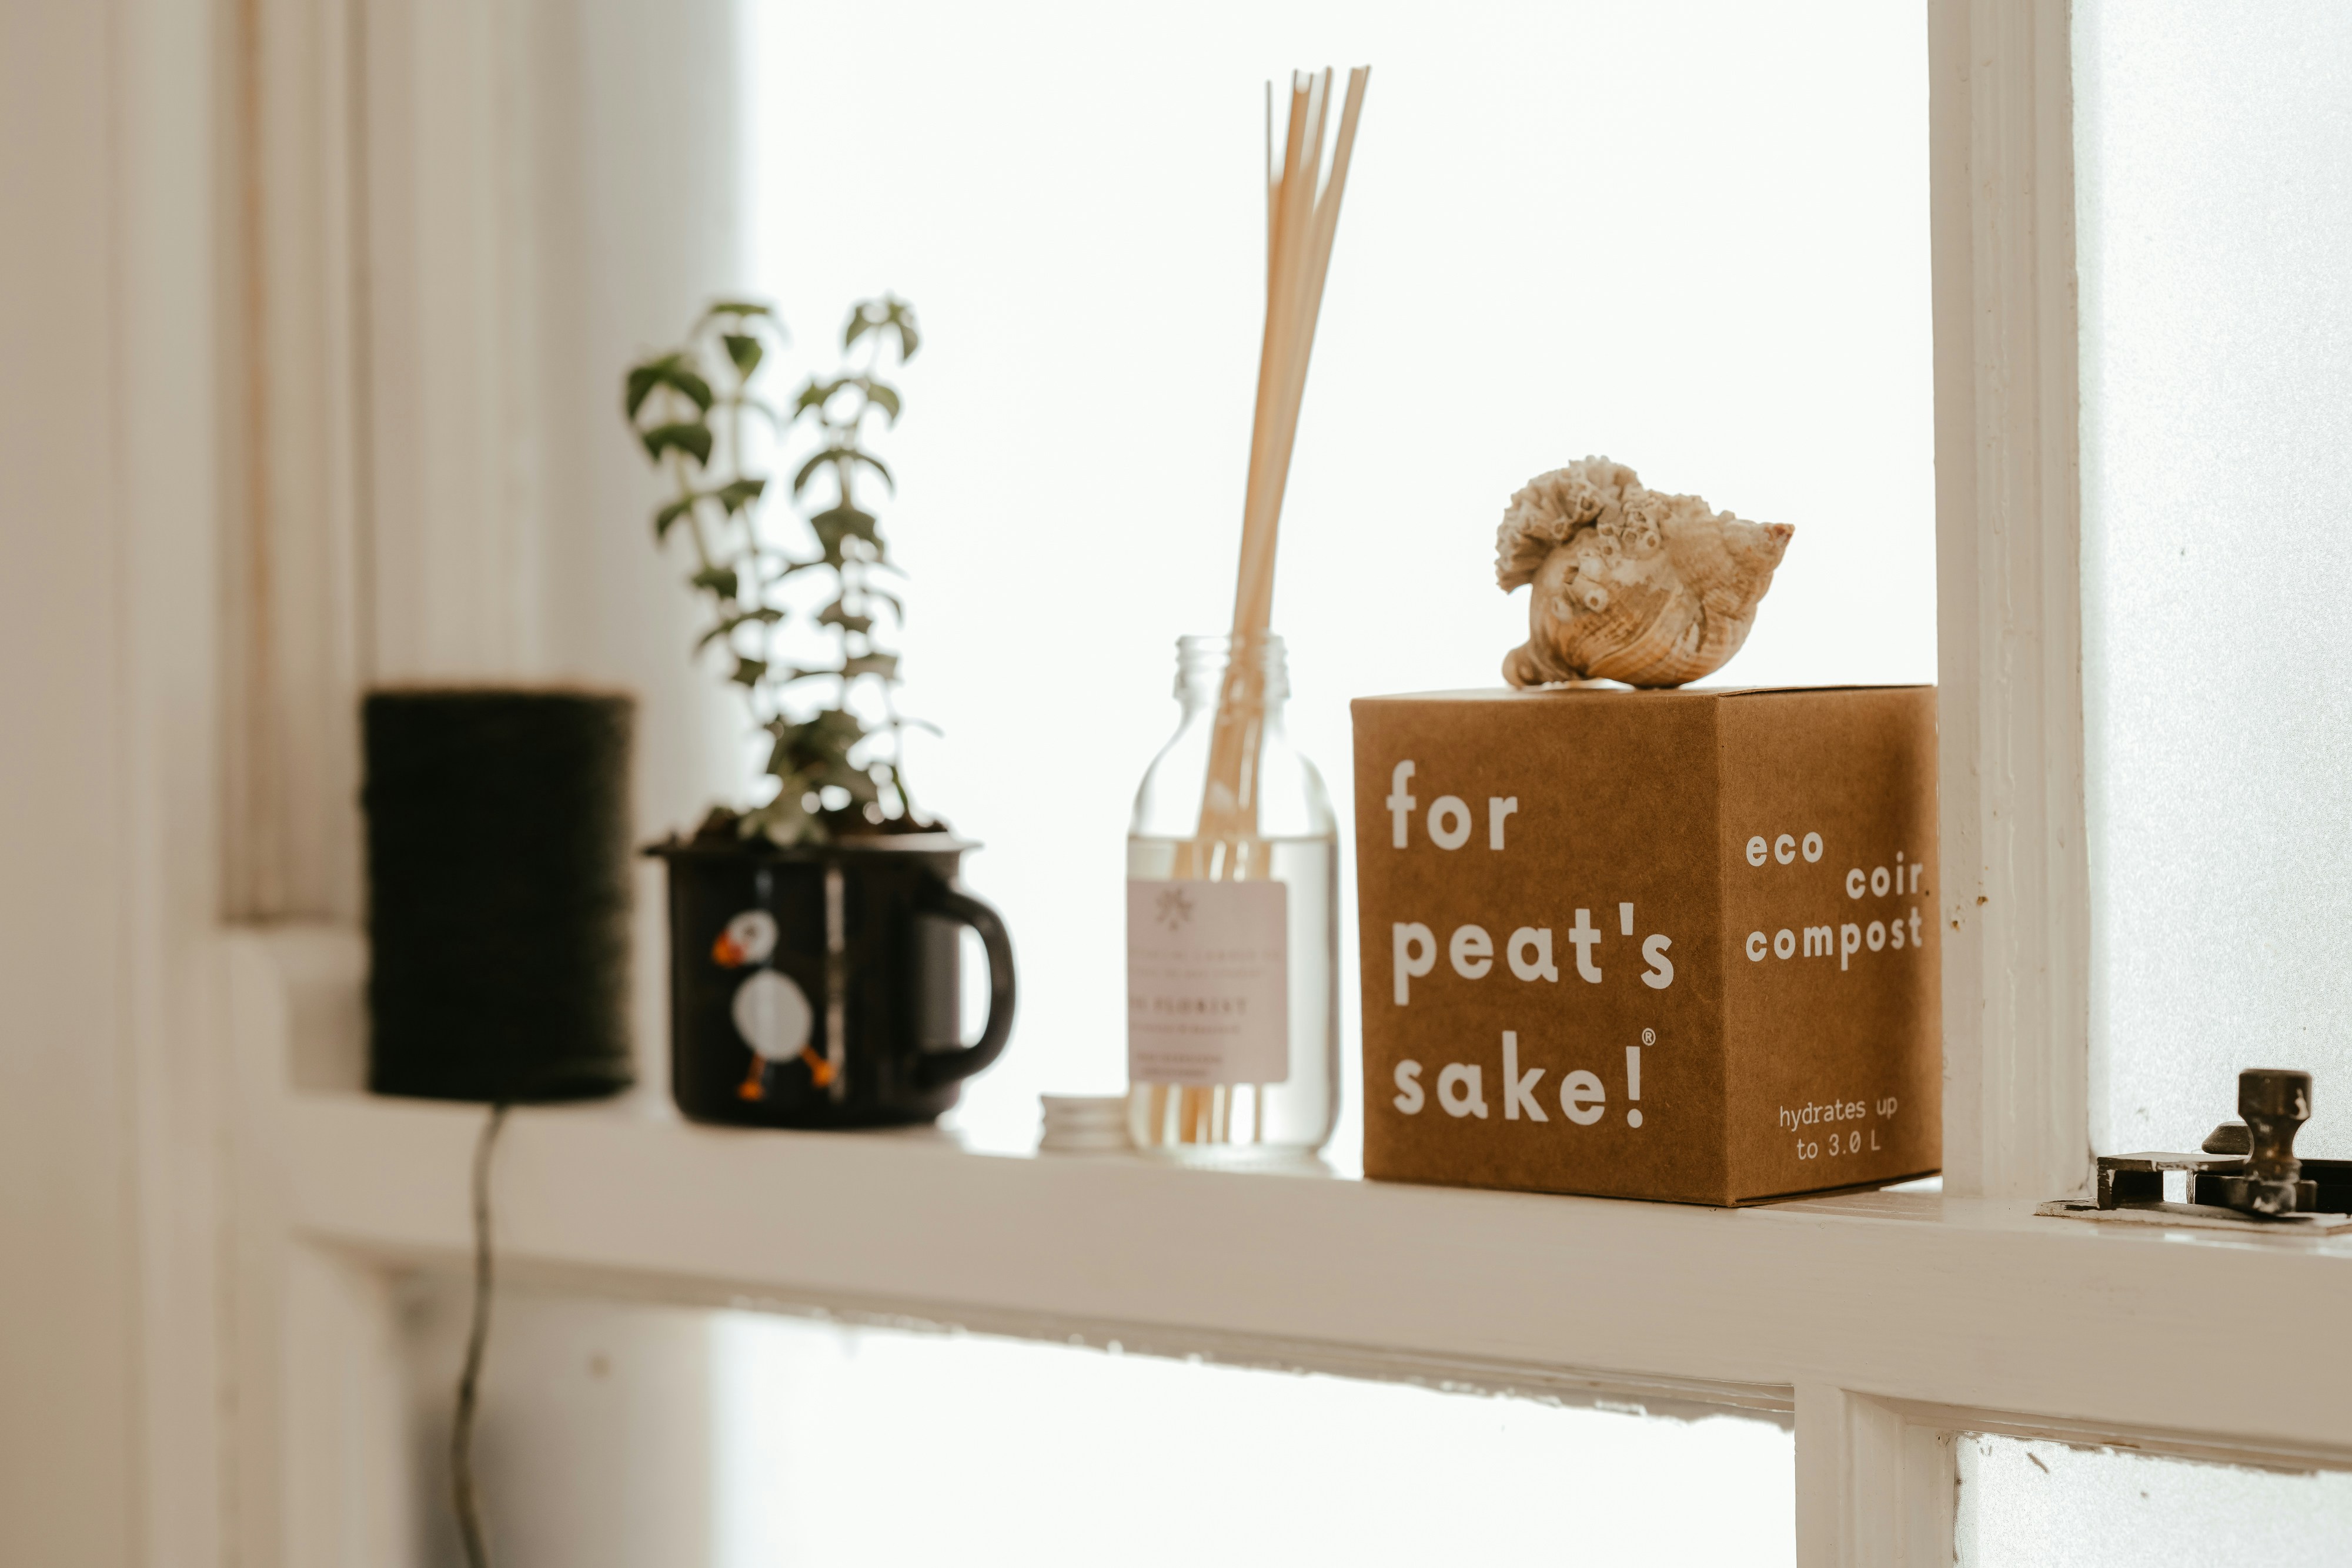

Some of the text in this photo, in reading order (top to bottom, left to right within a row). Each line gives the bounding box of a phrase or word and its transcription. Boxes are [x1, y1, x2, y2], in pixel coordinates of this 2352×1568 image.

[1385, 759, 1518, 851] for
[1746, 831, 1823, 867] eco
[1846, 851, 1923, 900] coir
[1392, 902, 1675, 1006] peat's
[1746, 907, 1923, 971] compost
[1780, 1096, 1898, 1132] hydrates up
[1797, 1129, 1881, 1160] to 3.0 L
